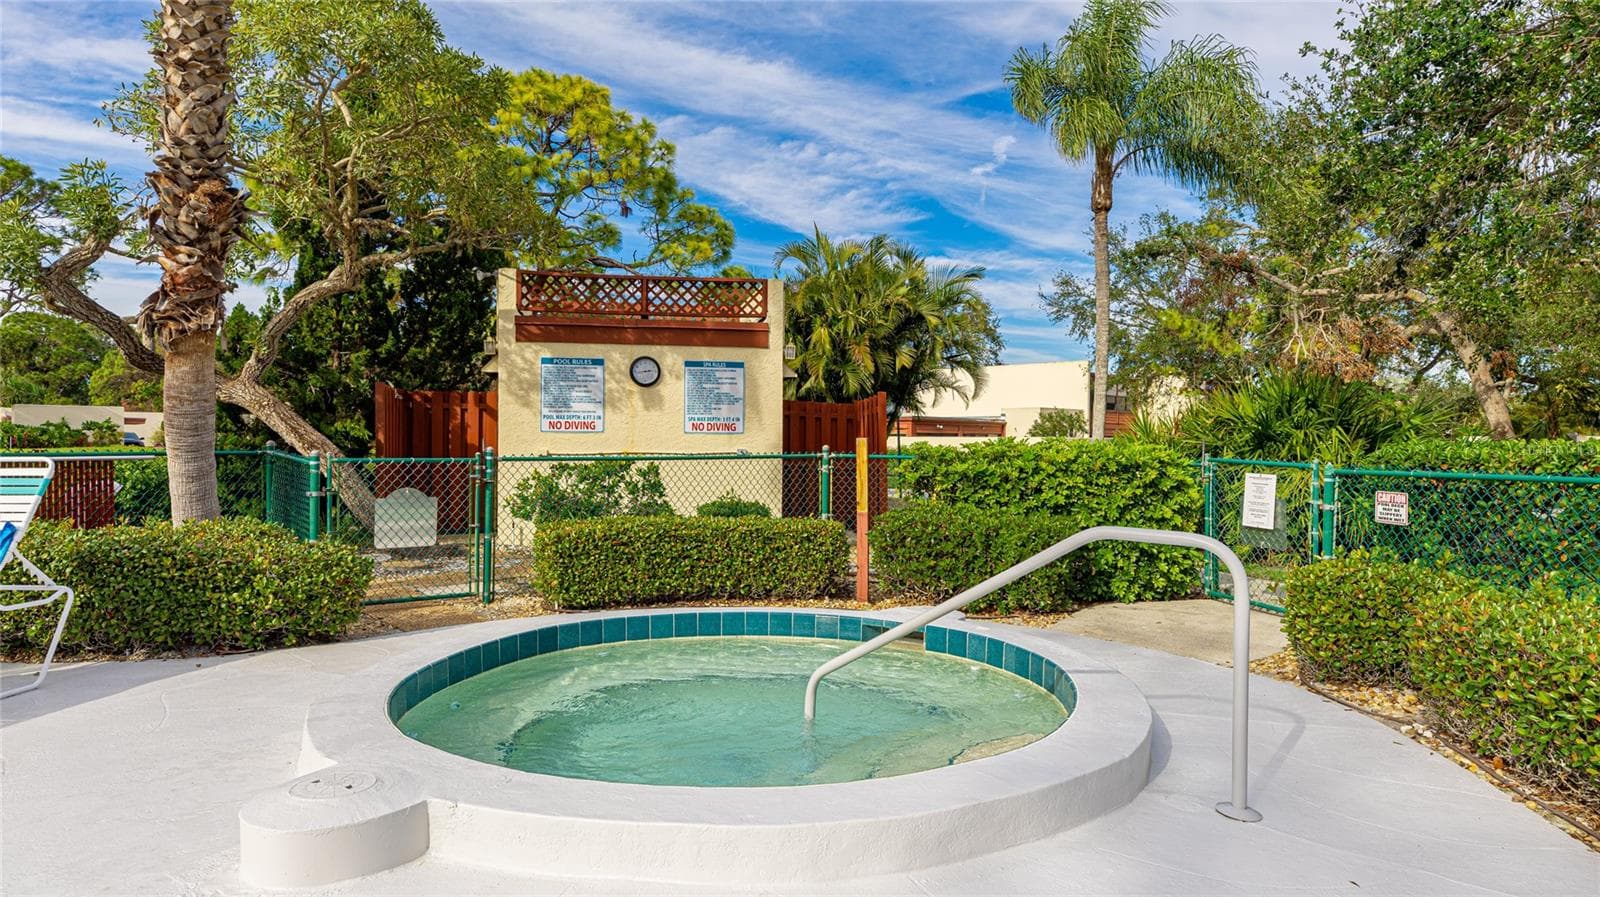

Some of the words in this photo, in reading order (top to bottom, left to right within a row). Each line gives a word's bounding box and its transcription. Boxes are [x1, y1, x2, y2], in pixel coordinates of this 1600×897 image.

[548, 420, 563, 430] NO
[564, 420, 596, 430] DIVING
[691, 422, 705, 431] NO
[706, 422, 737, 431] DIVING
[1378, 492, 1406, 503] CAUTION
